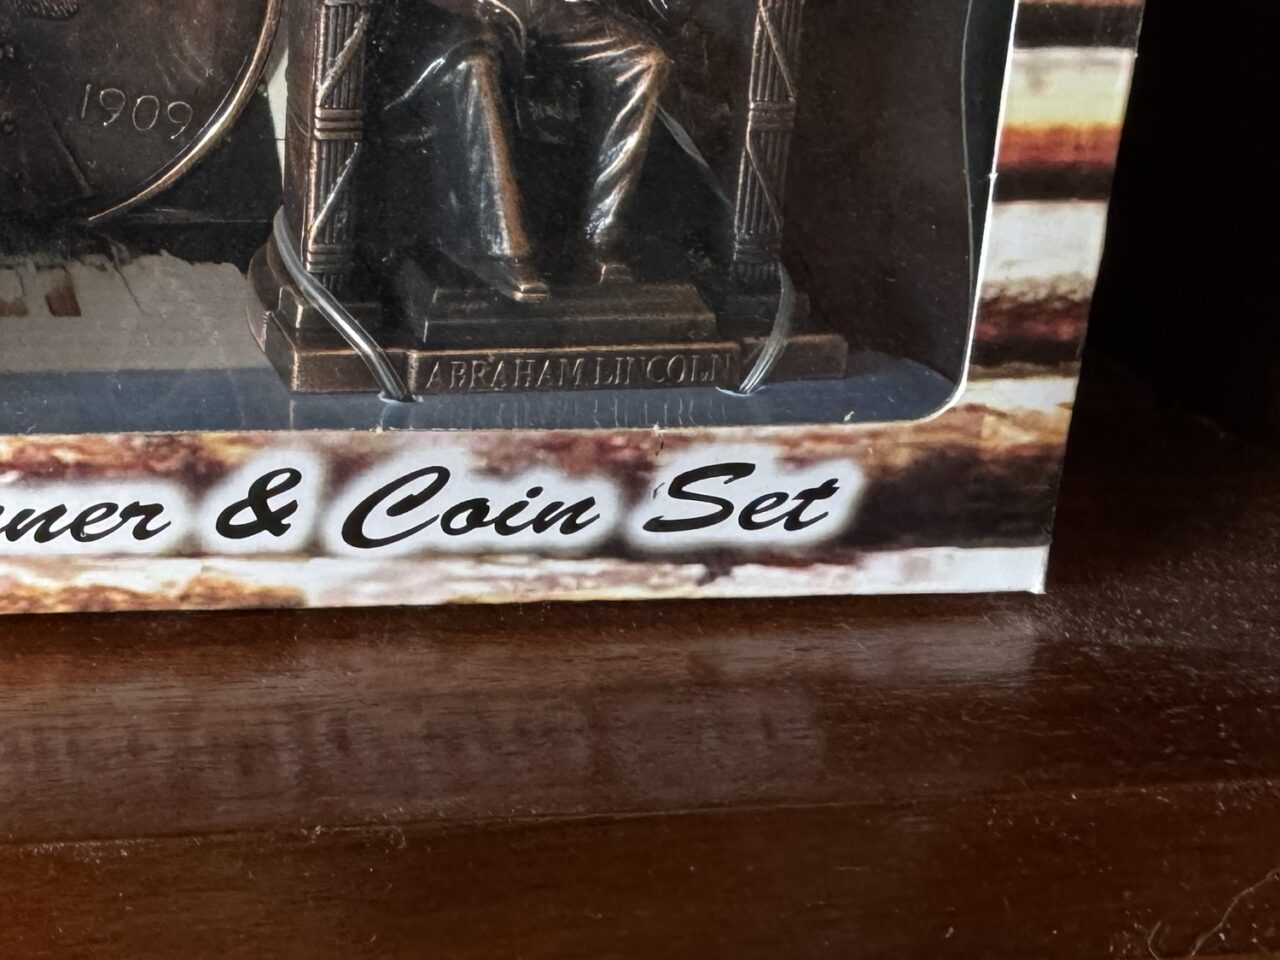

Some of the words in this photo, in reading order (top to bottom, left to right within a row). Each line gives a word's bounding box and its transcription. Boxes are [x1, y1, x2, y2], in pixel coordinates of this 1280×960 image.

[81, 83, 194, 140] 1909
[425, 358, 584, 388] ABRAHAM
[215, 467, 304, 539] &
[341, 465, 600, 549] Coin
[643, 461, 841, 533] Set
